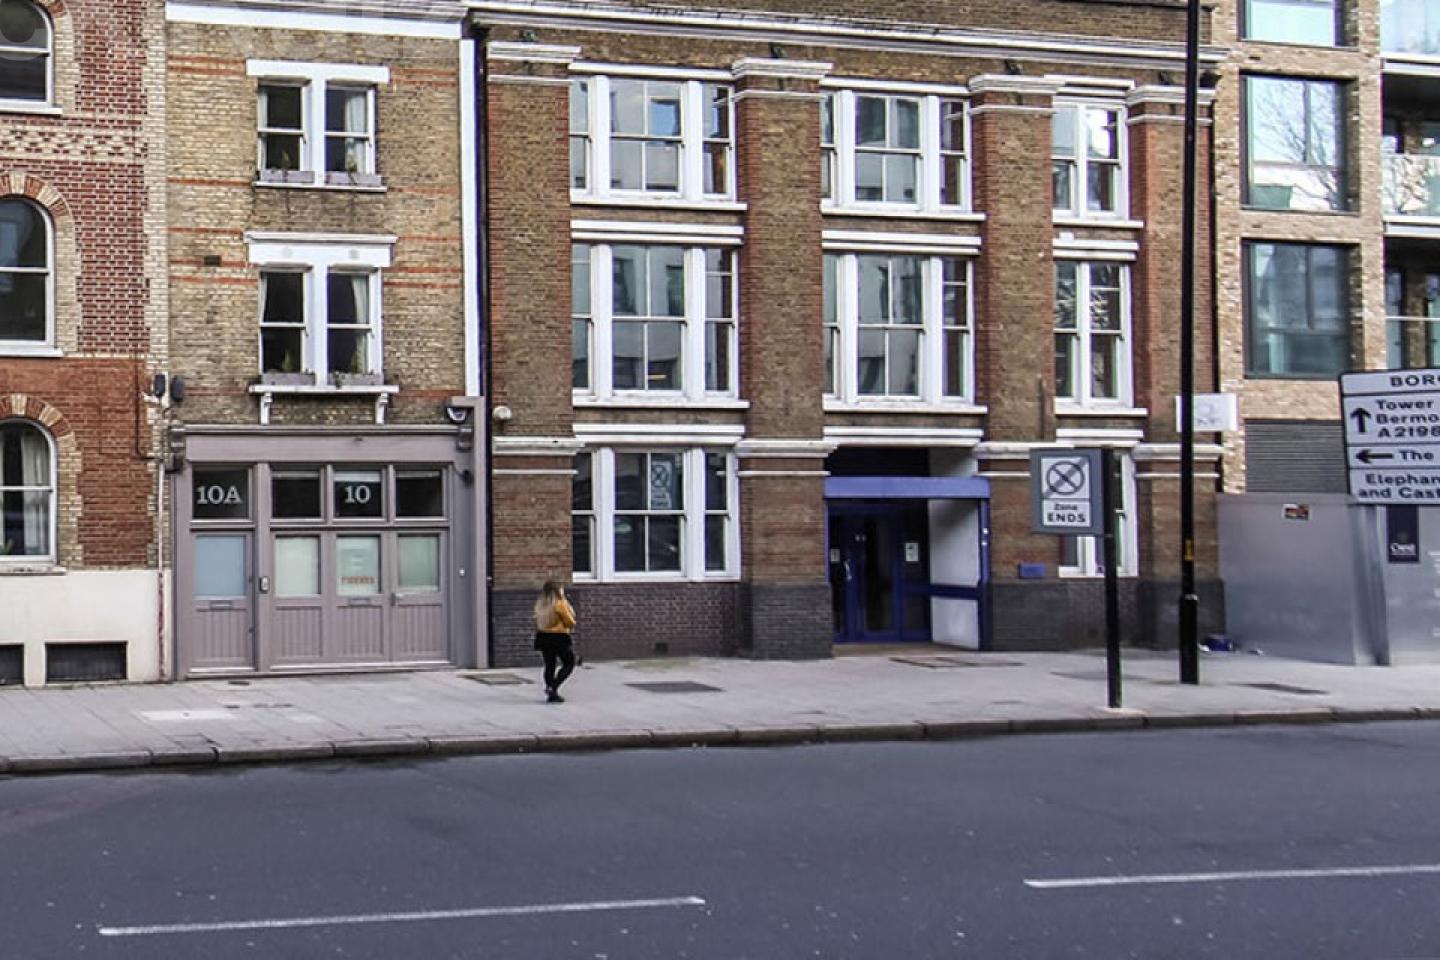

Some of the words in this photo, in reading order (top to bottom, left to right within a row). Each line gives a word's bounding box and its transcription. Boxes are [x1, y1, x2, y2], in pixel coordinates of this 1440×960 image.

[1389, 374, 1440, 387] BOR
[1376, 400, 1434, 410] Tower
[1398, 450, 1435, 460] The
[196, 485, 244, 504] 10A
[344, 485, 371, 504] 10
[1359, 487, 1392, 498] and
[1047, 512, 1086, 523] ENDS
